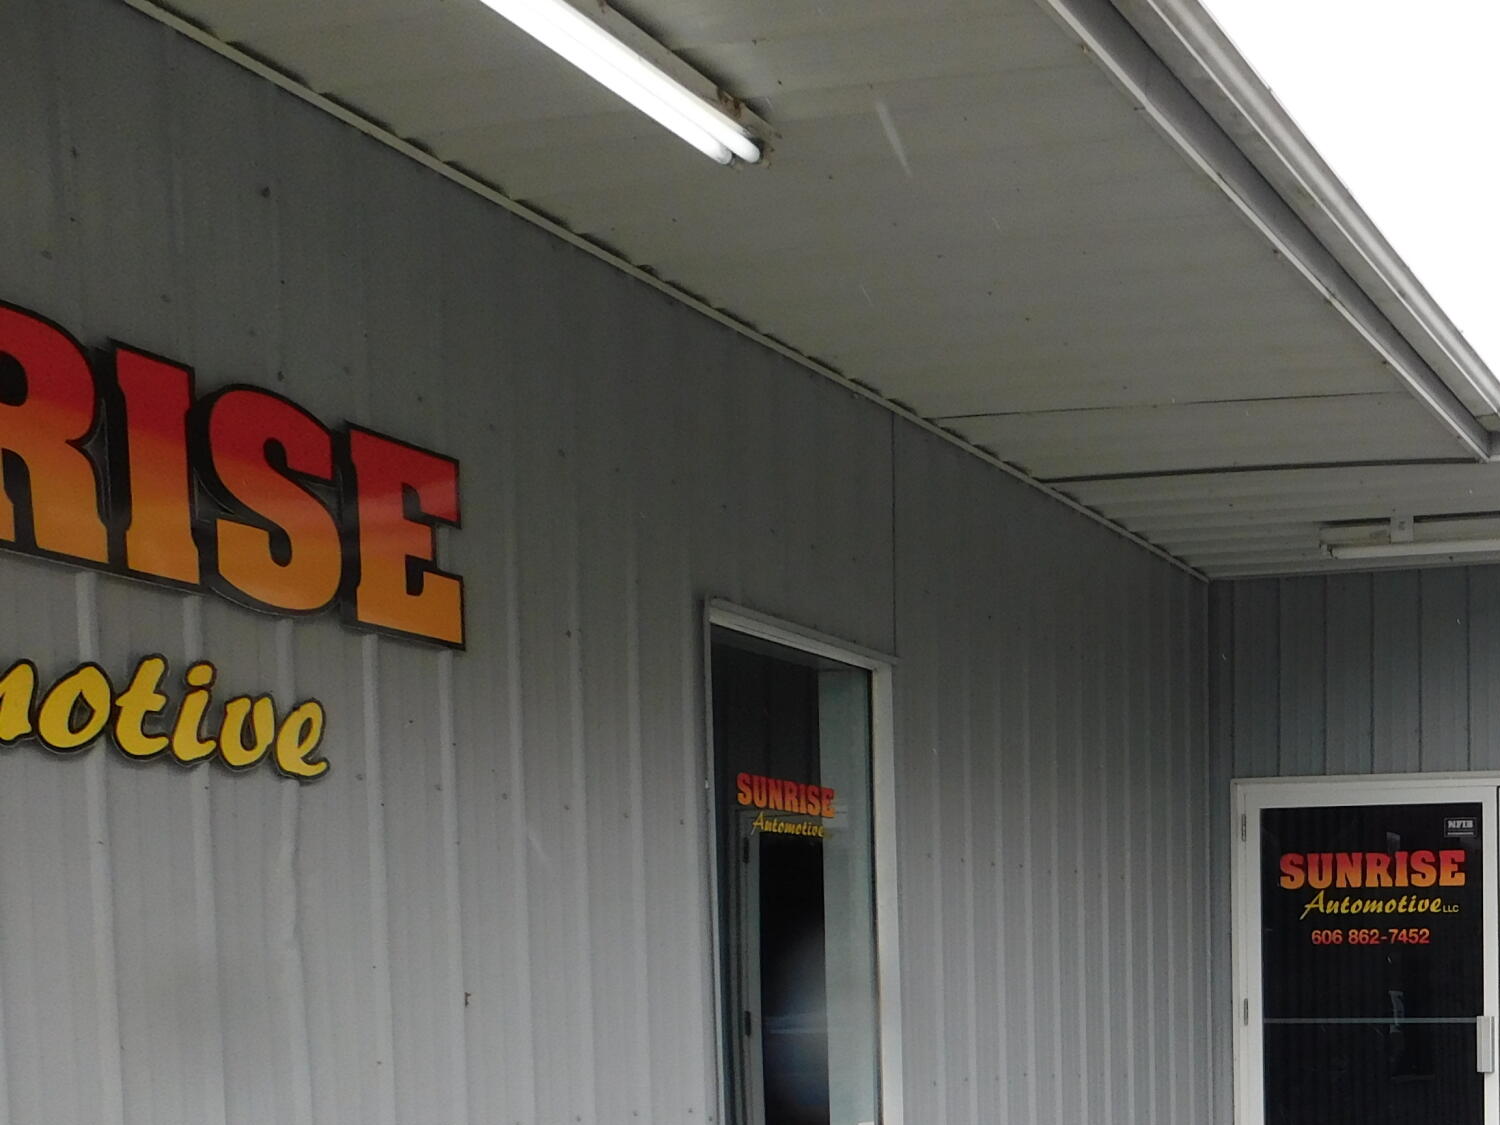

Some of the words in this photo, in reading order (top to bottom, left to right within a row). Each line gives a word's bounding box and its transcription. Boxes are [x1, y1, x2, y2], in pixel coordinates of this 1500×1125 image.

[737, 772, 836, 818] SUNRISE
[751, 811, 825, 837] Automotive
[1279, 850, 1466, 889] SUNRISE
[1300, 889, 1442, 920] Automotive
[1442, 904, 1460, 913] LLC
[1311, 930, 1343, 944] 606
[1348, 928, 1430, 944] 862-7452
